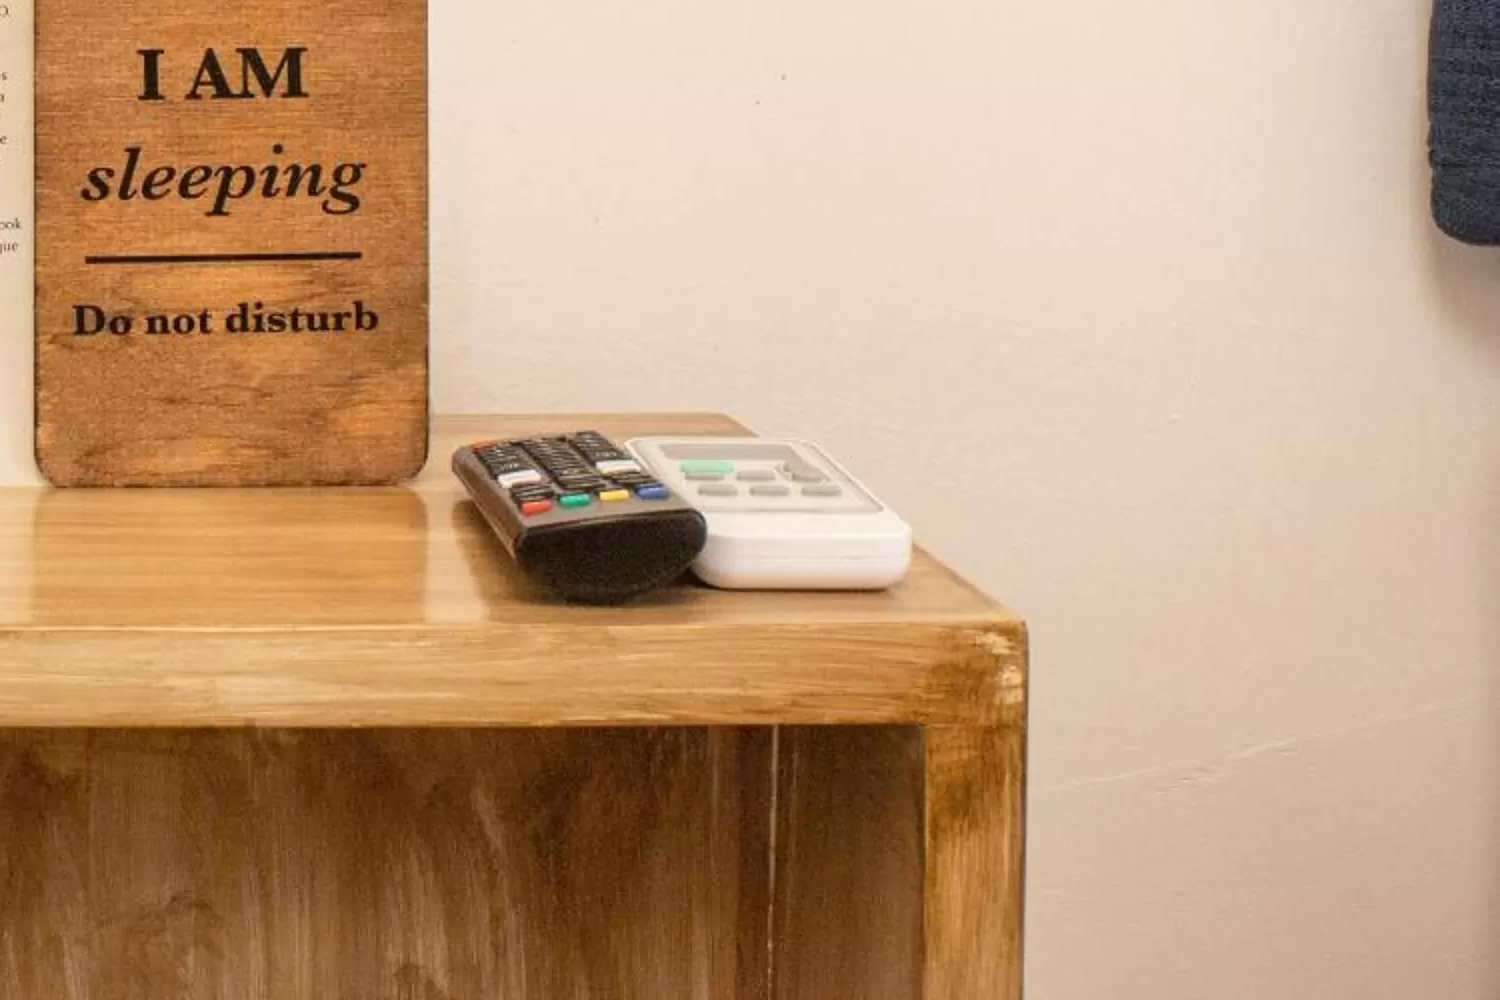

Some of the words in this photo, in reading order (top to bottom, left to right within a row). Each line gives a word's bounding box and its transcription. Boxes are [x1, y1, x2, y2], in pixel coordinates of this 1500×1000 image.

[136, 49, 165, 101] I
[185, 46, 309, 100] AM
[81, 143, 367, 217] sleeping
[73, 304, 133, 336] Do
[146, 307, 212, 335] not
[225, 301, 379, 333] disturb
